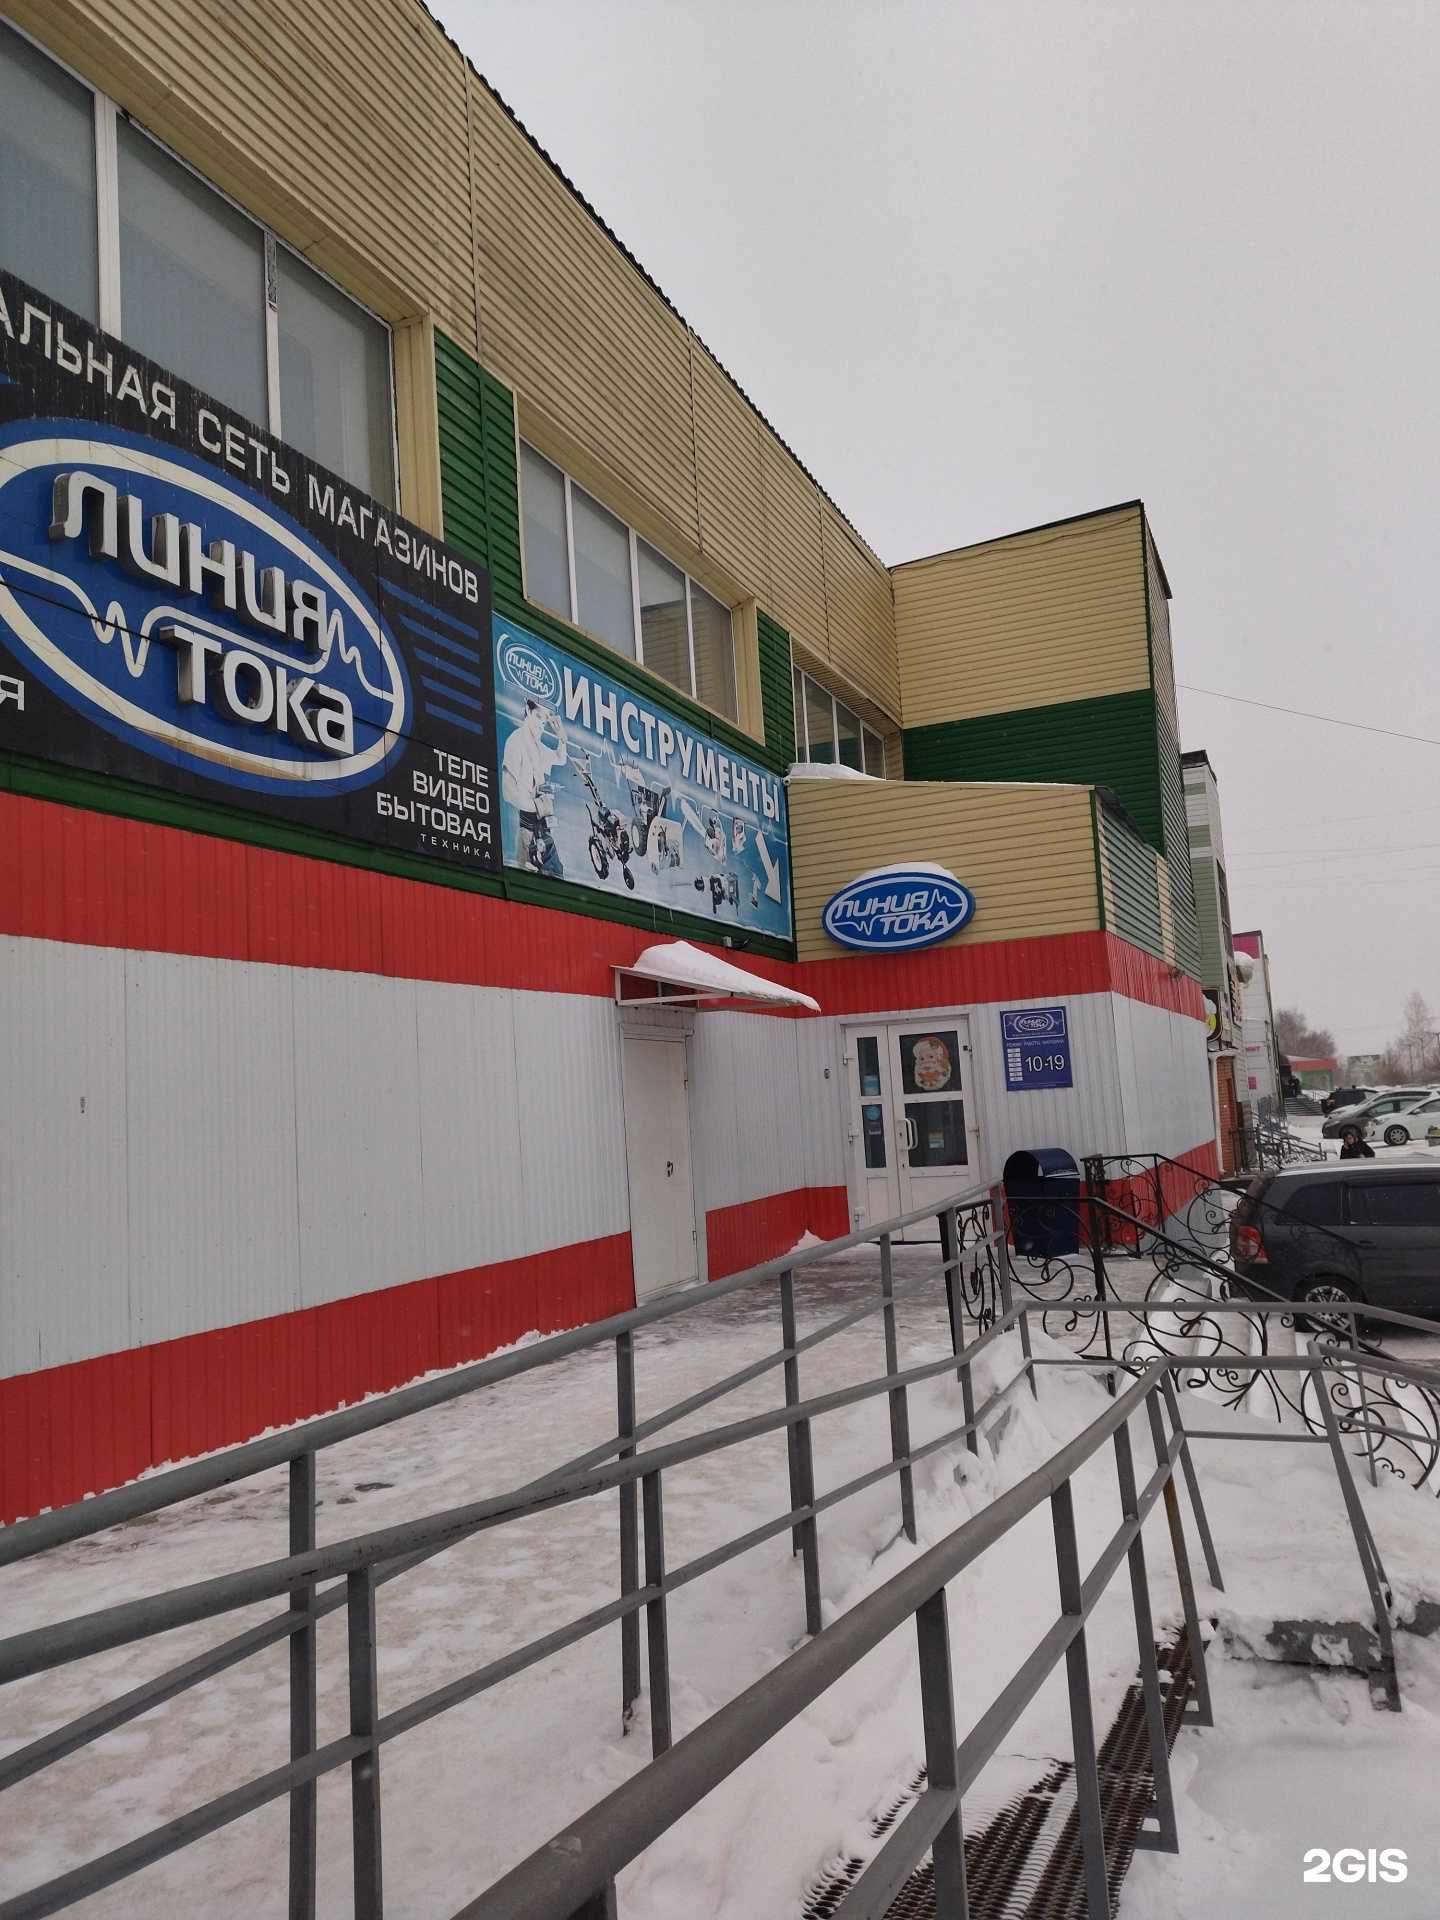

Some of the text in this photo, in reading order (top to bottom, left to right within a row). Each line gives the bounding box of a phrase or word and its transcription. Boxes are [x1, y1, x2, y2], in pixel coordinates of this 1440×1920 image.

[198, 409, 290, 494] СЕТЬ
[308, 473, 479, 604] МАГАЗИНОВ
[564, 666, 780, 822] ИНСТРУМЕНТЫ
[433, 748, 489, 788] ТЕЛЕ
[413, 770, 490, 814] ВИДЕО
[376, 791, 491, 844] БЫТОВАЯ
[420, 833, 491, 860] ТЕХНИКА
[834, 890, 929, 920] ЛИНИЯ
[880, 911, 950, 936] ТОКА
